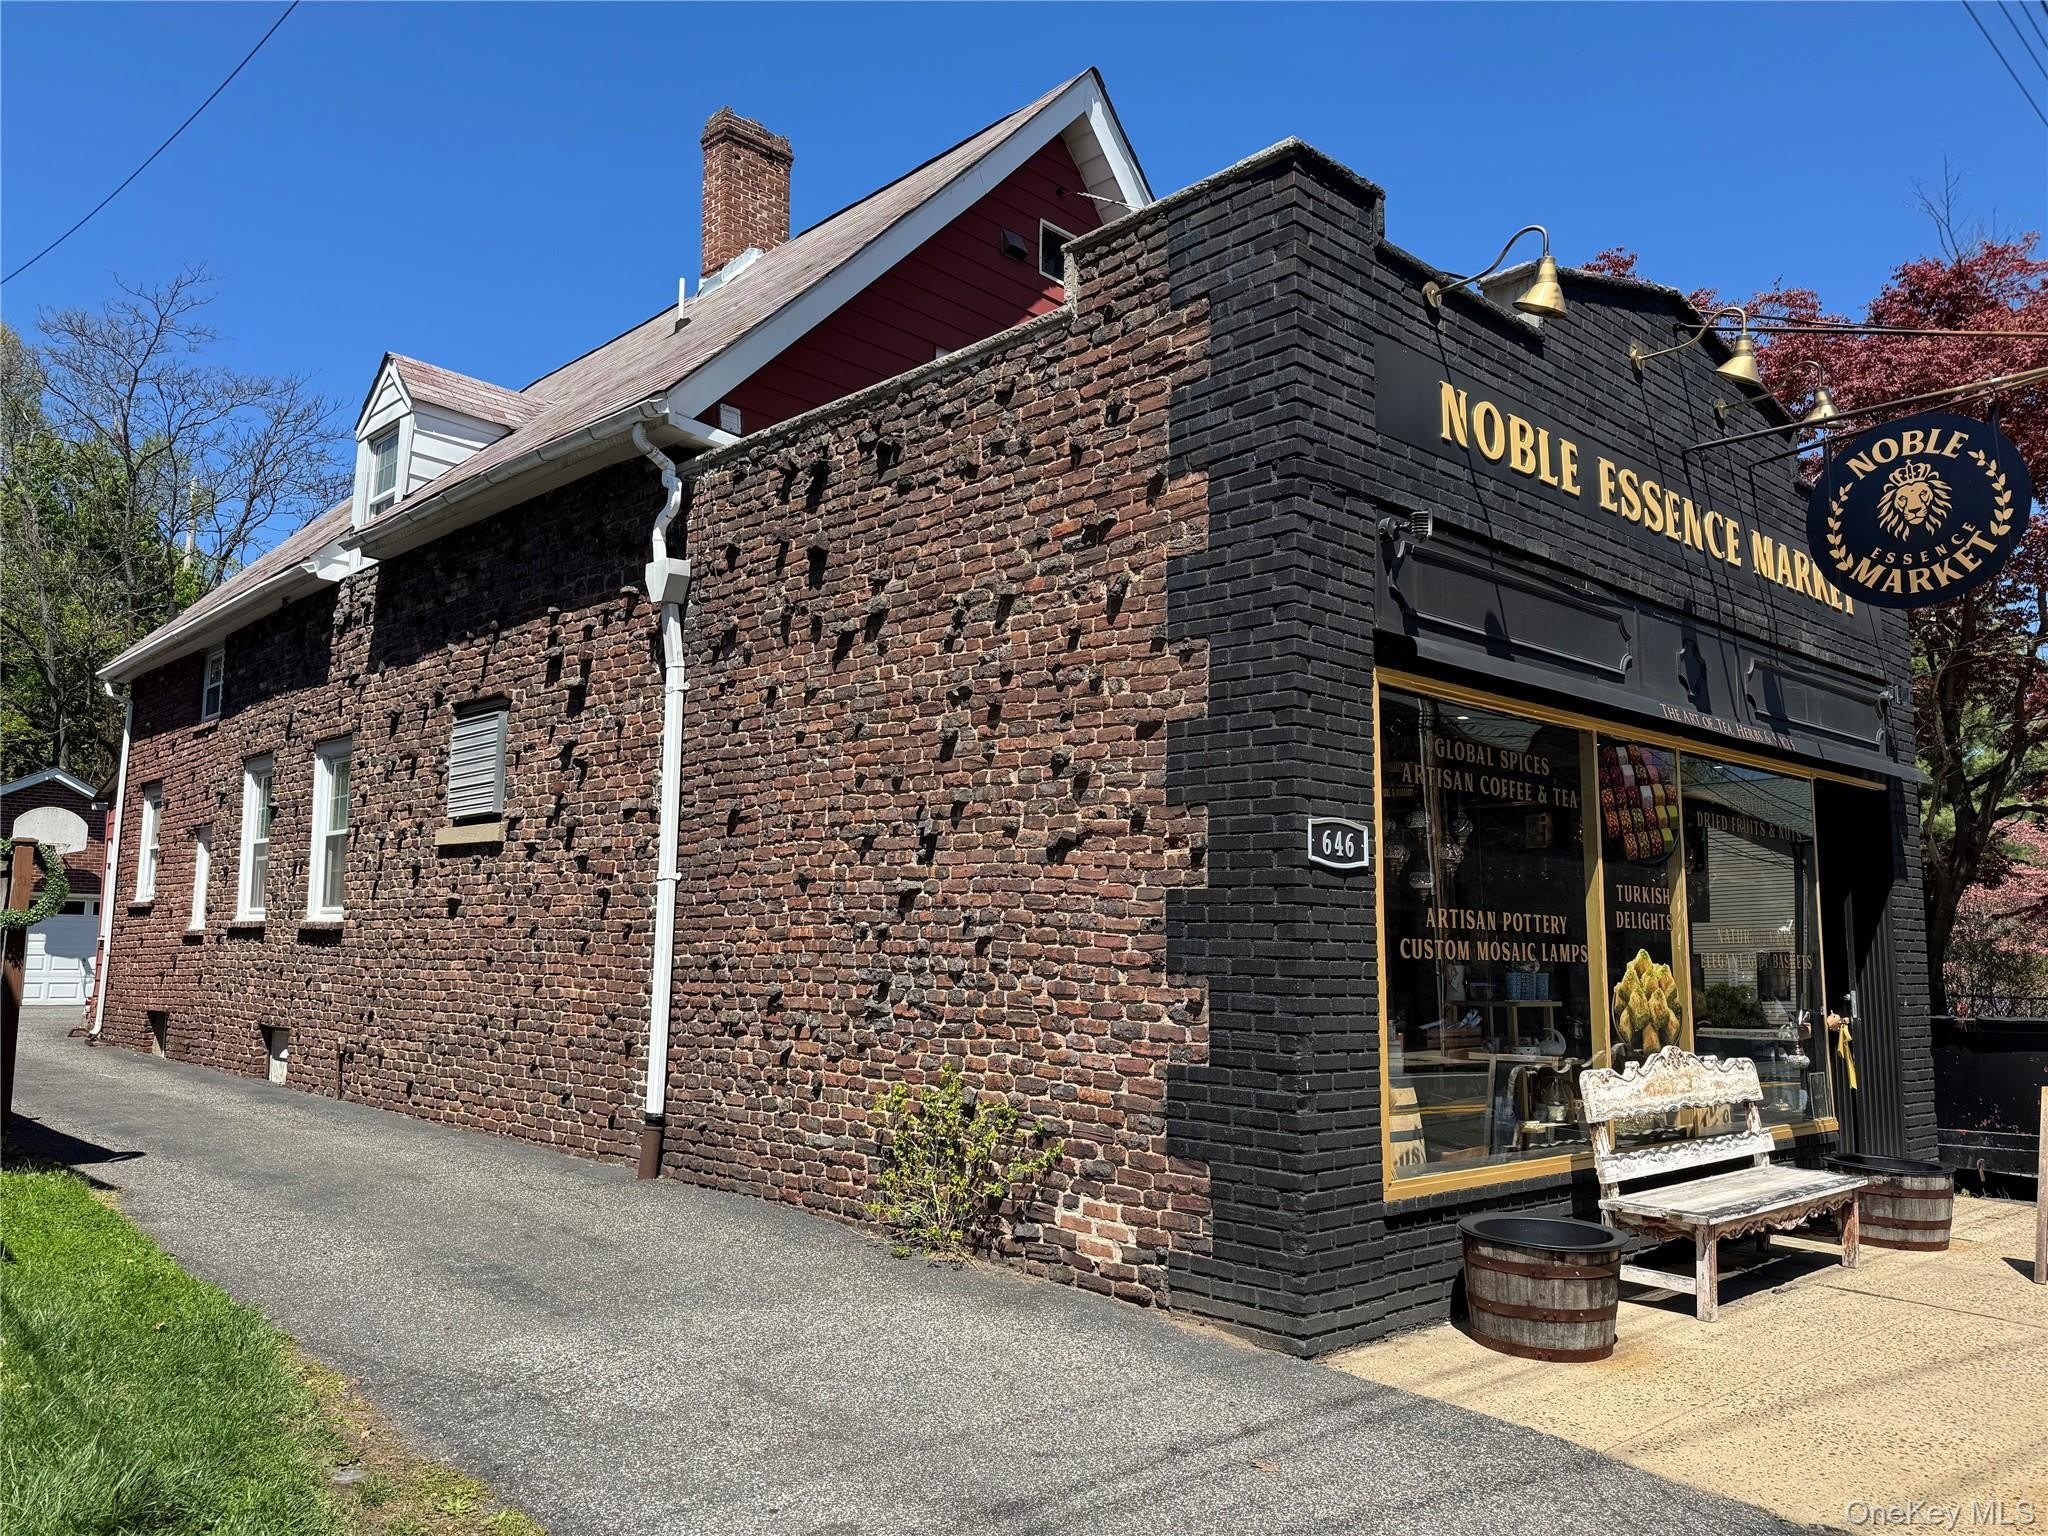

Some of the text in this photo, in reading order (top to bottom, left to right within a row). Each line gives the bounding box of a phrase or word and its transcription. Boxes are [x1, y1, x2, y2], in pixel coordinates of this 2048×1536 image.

[1846, 428, 1970, 480] NOBLE
[1439, 380, 1582, 497] NOBLE
[1597, 456, 1743, 568] ESSENCE
[1870, 521, 1976, 565] ESSENCE
[1849, 530, 1998, 594] MARKET
[1660, 703, 1682, 721] THE
[1683, 710, 1701, 727] ART
[1434, 738, 1550, 777] GLOBAL SPICES
[1402, 762, 1475, 793] ARTISAN
[1480, 775, 1533, 801] COFFEE
[1538, 784, 1548, 805] &
[1553, 787, 1579, 810] TEA
[1697, 810, 1729, 831] DRIED
[1731, 815, 1767, 838] FRUITS
[1768, 822, 1776, 838] &
[1322, 829, 1355, 858] 646
[1616, 884, 1671, 905] TURKISH
[1426, 907, 1568, 935] ARTISAN POTTERY
[1615, 910, 1673, 931] DELIGHTS
[1400, 937, 1589, 964] CUSTOM MOSAIC LAMPS
